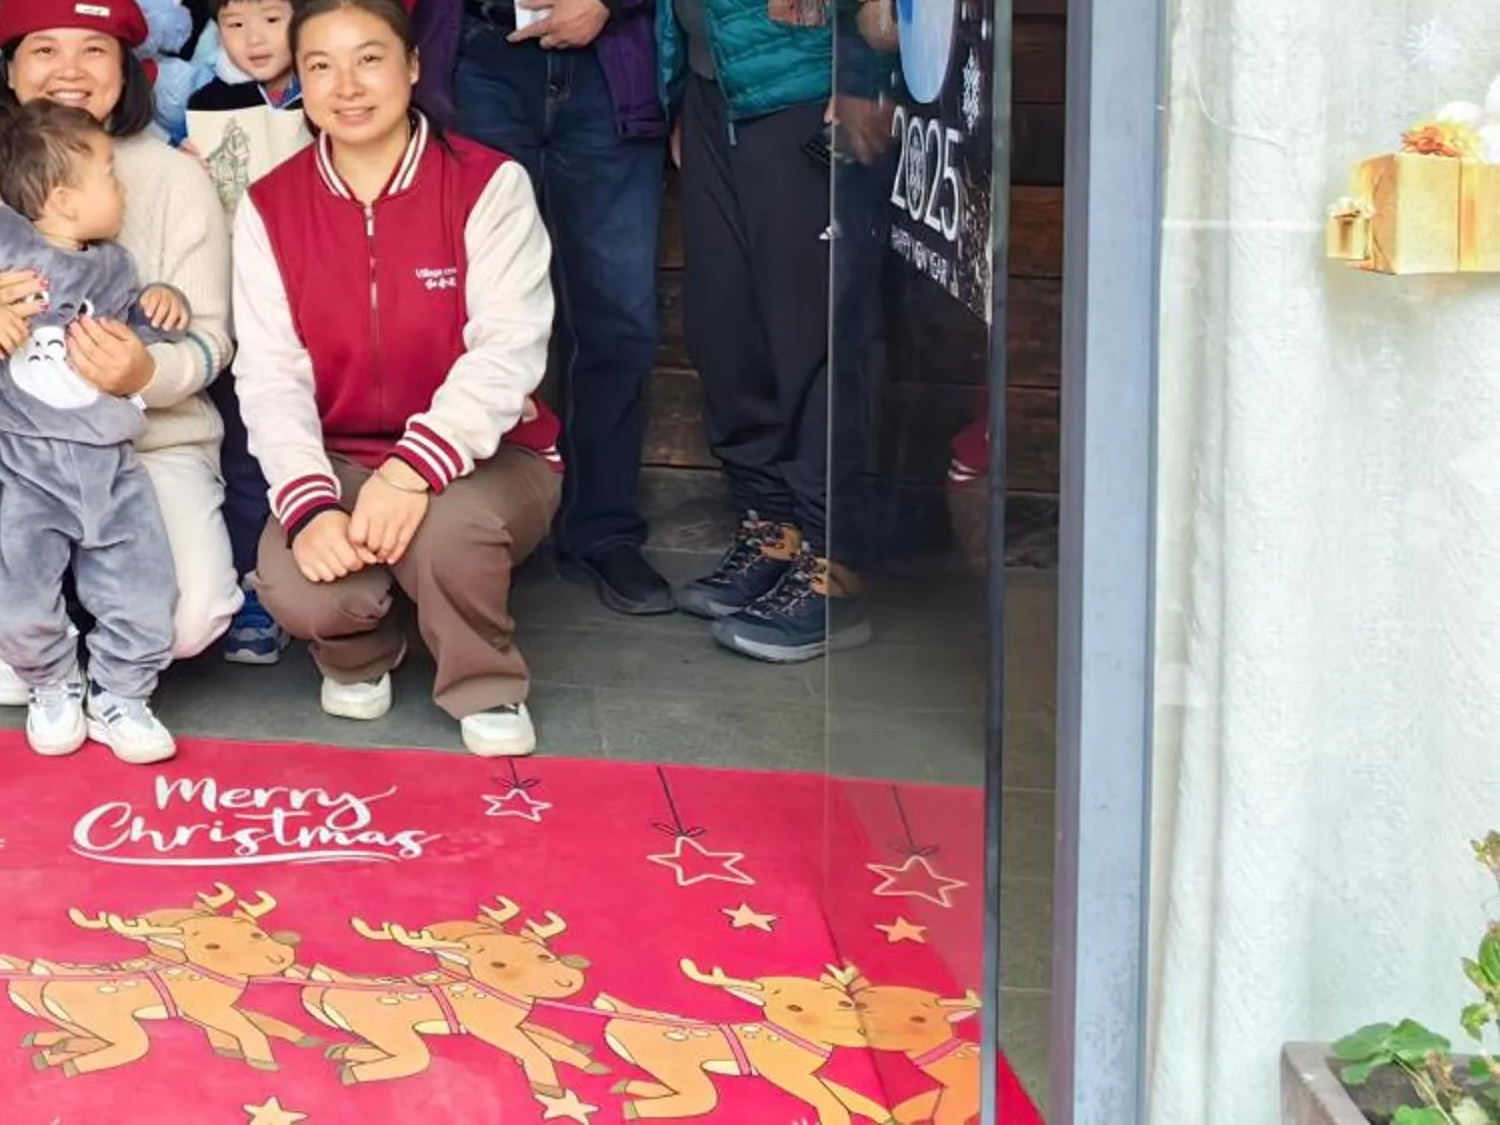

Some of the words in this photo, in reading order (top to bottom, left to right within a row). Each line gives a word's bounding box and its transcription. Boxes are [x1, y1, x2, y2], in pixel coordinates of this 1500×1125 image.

[891, 106, 963, 241] 2025
[73, 801, 442, 859] Christmas
[155, 774, 397, 831] Merry
